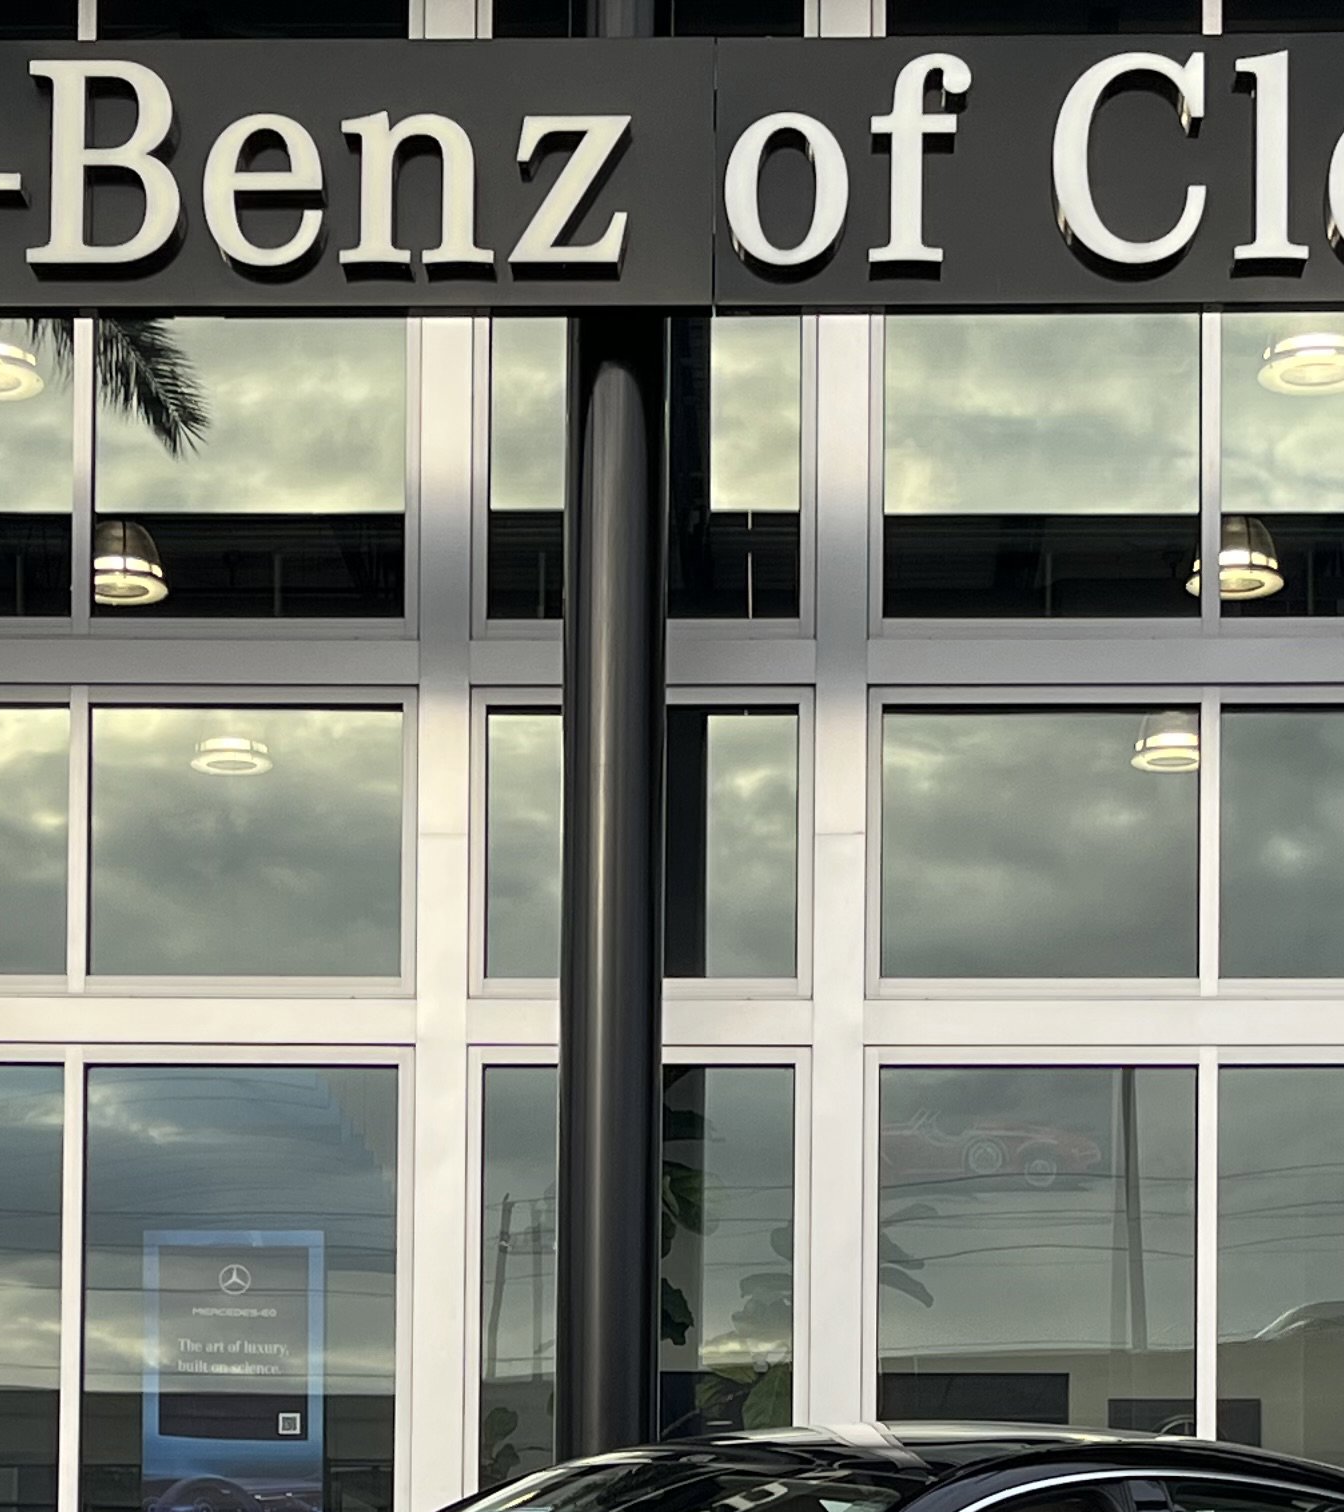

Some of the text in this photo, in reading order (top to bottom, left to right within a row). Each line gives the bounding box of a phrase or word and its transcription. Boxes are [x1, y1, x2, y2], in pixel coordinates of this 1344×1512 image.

[722, 51, 972, 268] of
[178, 1338, 289, 1357] The art of luxury,
[178, 1360, 208, 1373] built
[211, 1363, 228, 1374] on
